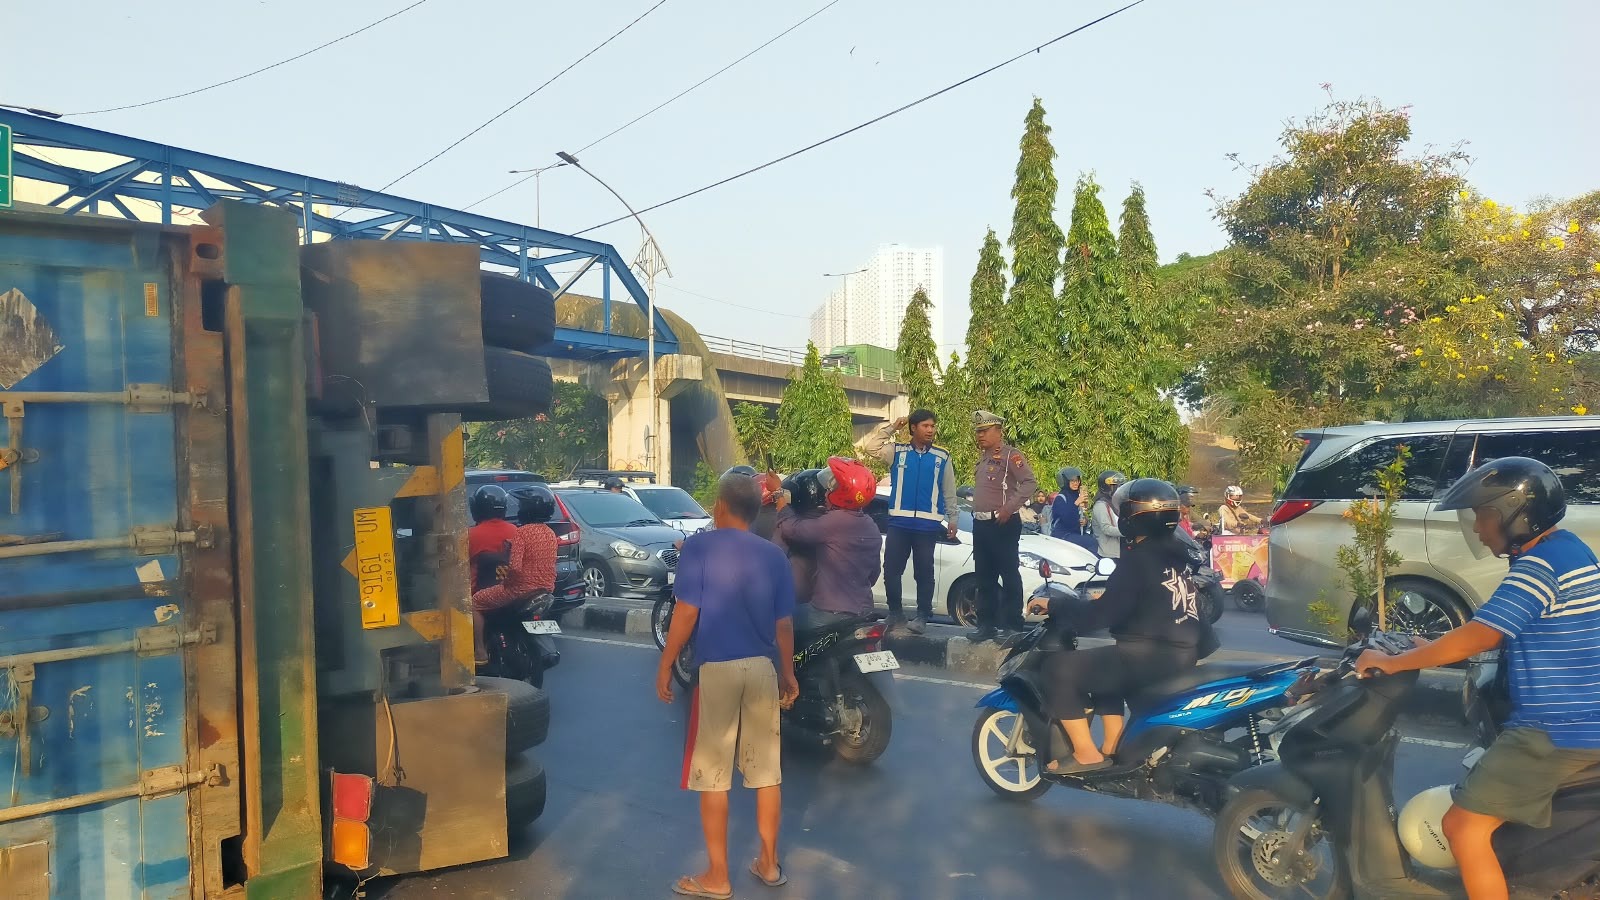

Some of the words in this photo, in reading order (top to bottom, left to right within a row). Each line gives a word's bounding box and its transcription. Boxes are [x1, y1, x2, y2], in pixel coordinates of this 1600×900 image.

[356, 510, 378, 533] UM
[359, 553, 384, 595] 9161
[364, 613, 386, 625] L
